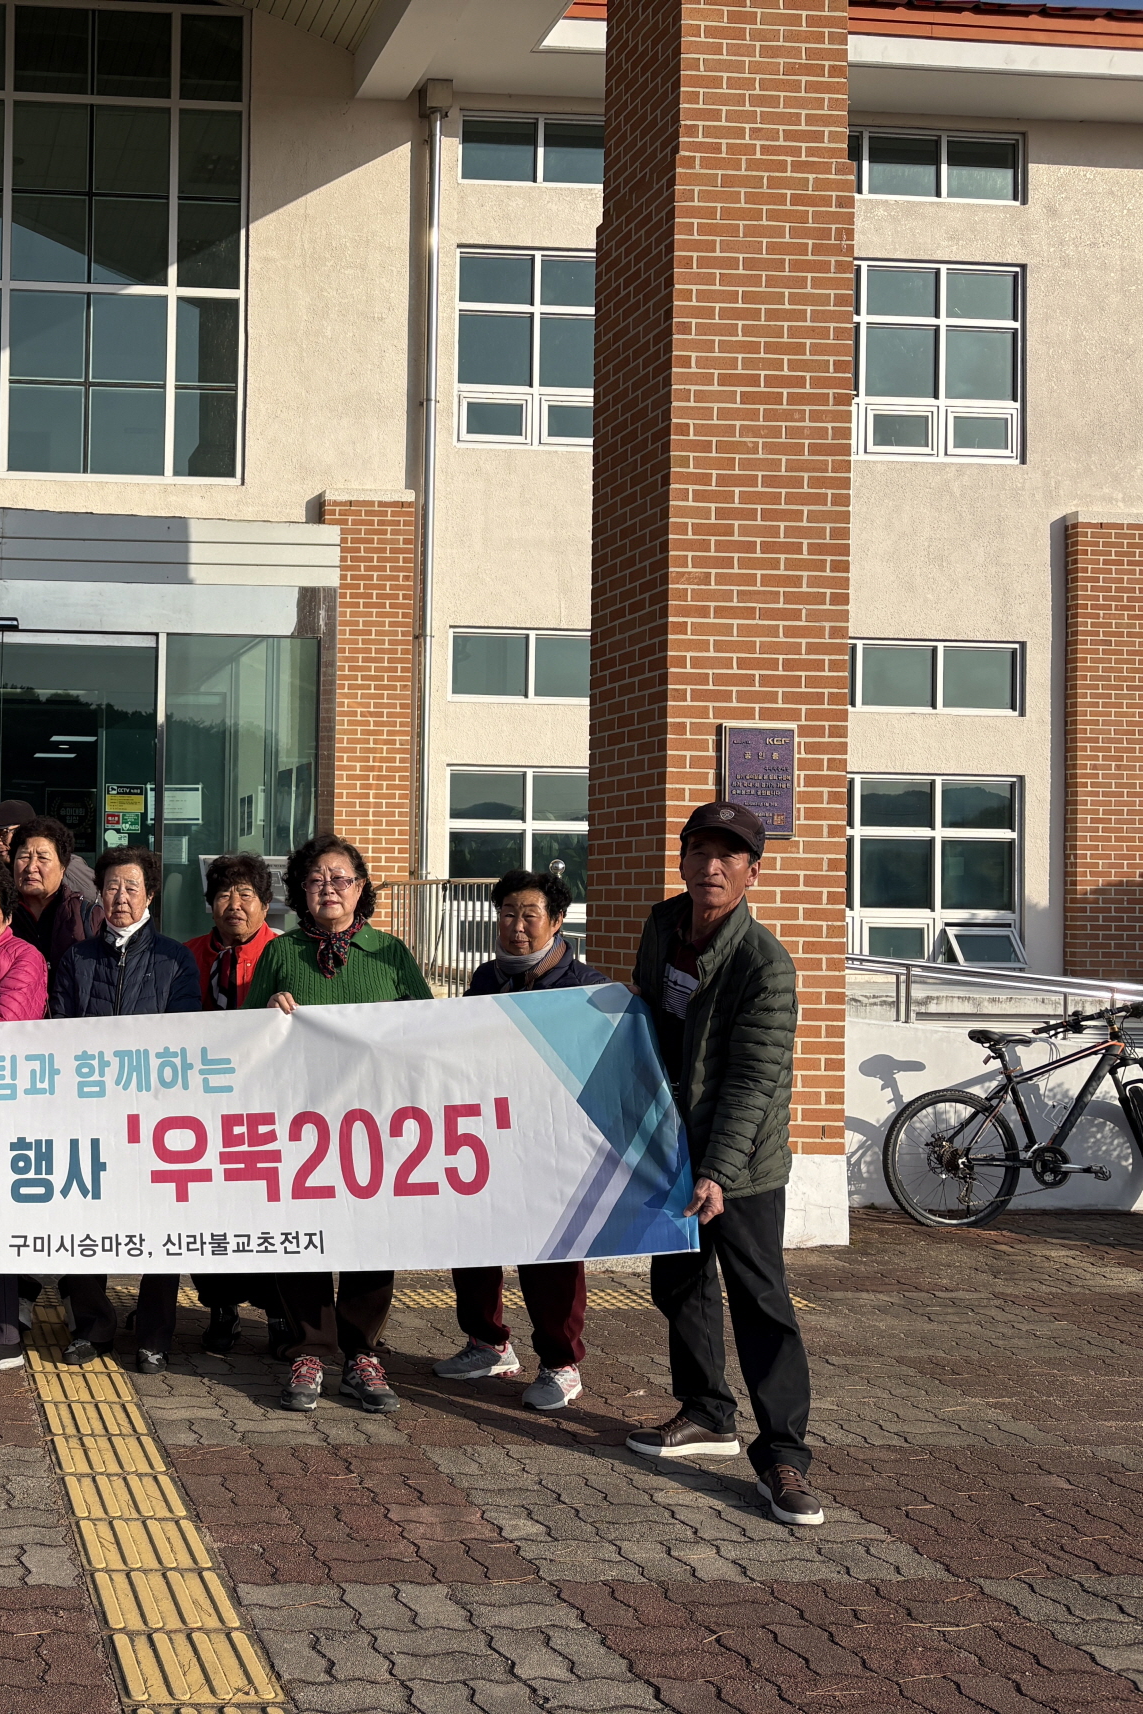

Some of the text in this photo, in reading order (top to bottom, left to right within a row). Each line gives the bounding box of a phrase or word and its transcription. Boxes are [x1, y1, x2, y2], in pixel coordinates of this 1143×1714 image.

[74, 1046, 237, 1099] 함께하는
[9, 1136, 108, 1204] 행사
[126, 1096, 512, 1204] '우뚝2025'
[8, 1232, 154, 1259] 구미시승마장,
[161, 1230, 325, 1257] 신라불교초전지
